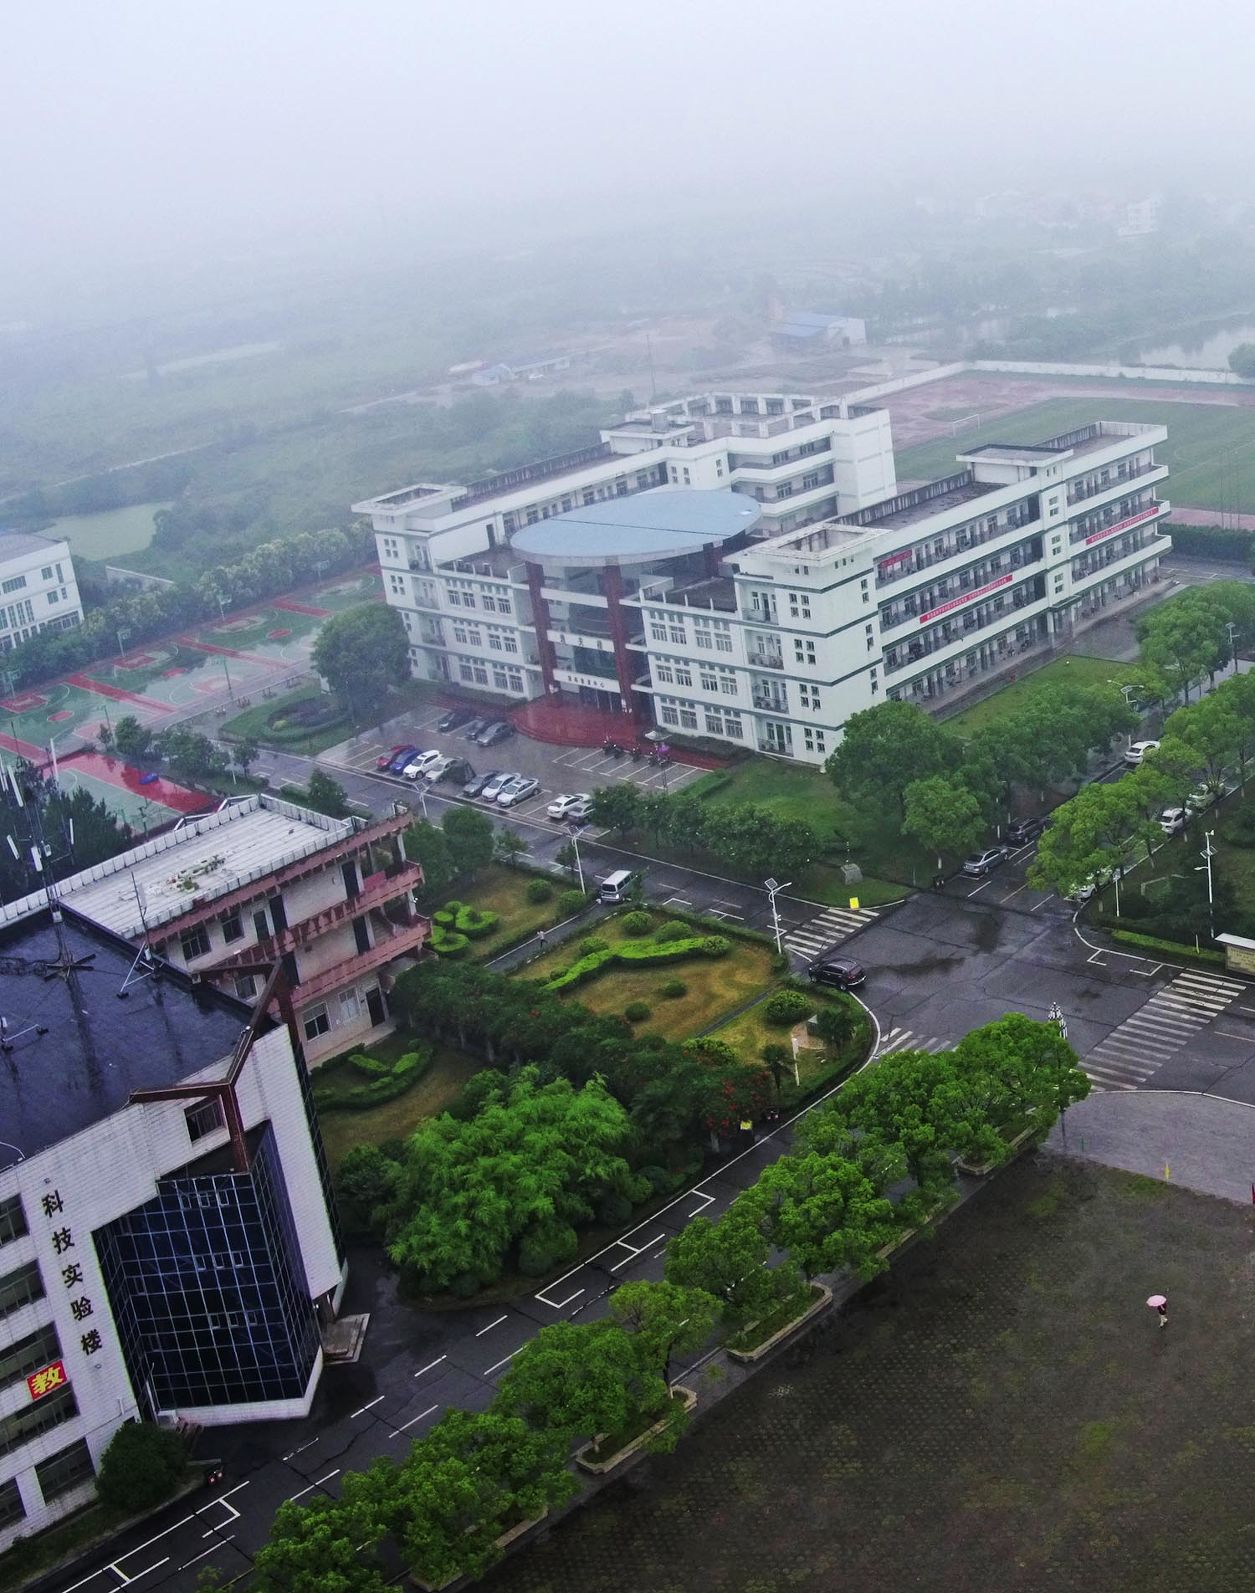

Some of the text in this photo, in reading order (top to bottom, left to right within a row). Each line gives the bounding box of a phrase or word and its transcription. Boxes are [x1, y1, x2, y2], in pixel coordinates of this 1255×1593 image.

[41, 1189, 103, 1356] 科技实验楼
[31, 1366, 64, 1394] 教
